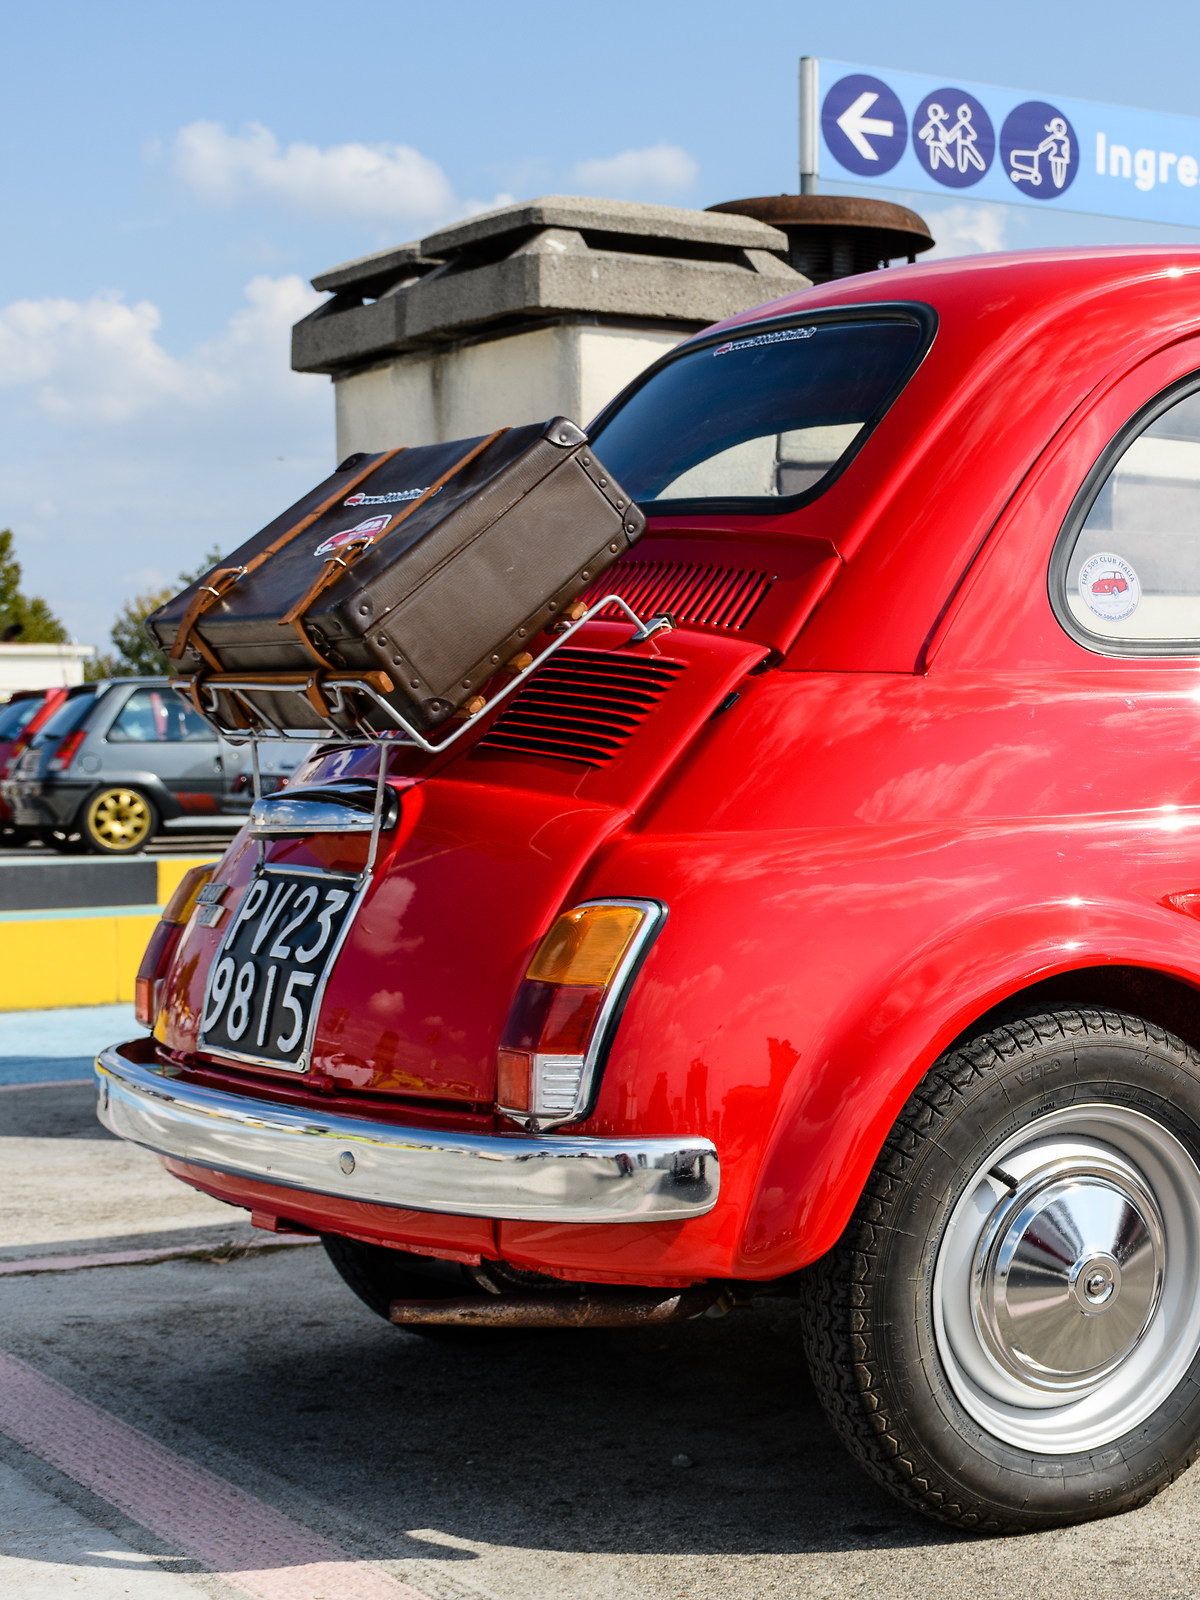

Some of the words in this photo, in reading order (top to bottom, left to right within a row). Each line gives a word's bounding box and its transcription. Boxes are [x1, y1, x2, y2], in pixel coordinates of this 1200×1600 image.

[1087, 559, 1098, 569] 500
[1118, 561, 1135, 582] ITALIA
[225, 879, 350, 964] PV23
[203, 956, 317, 1053] 9815
